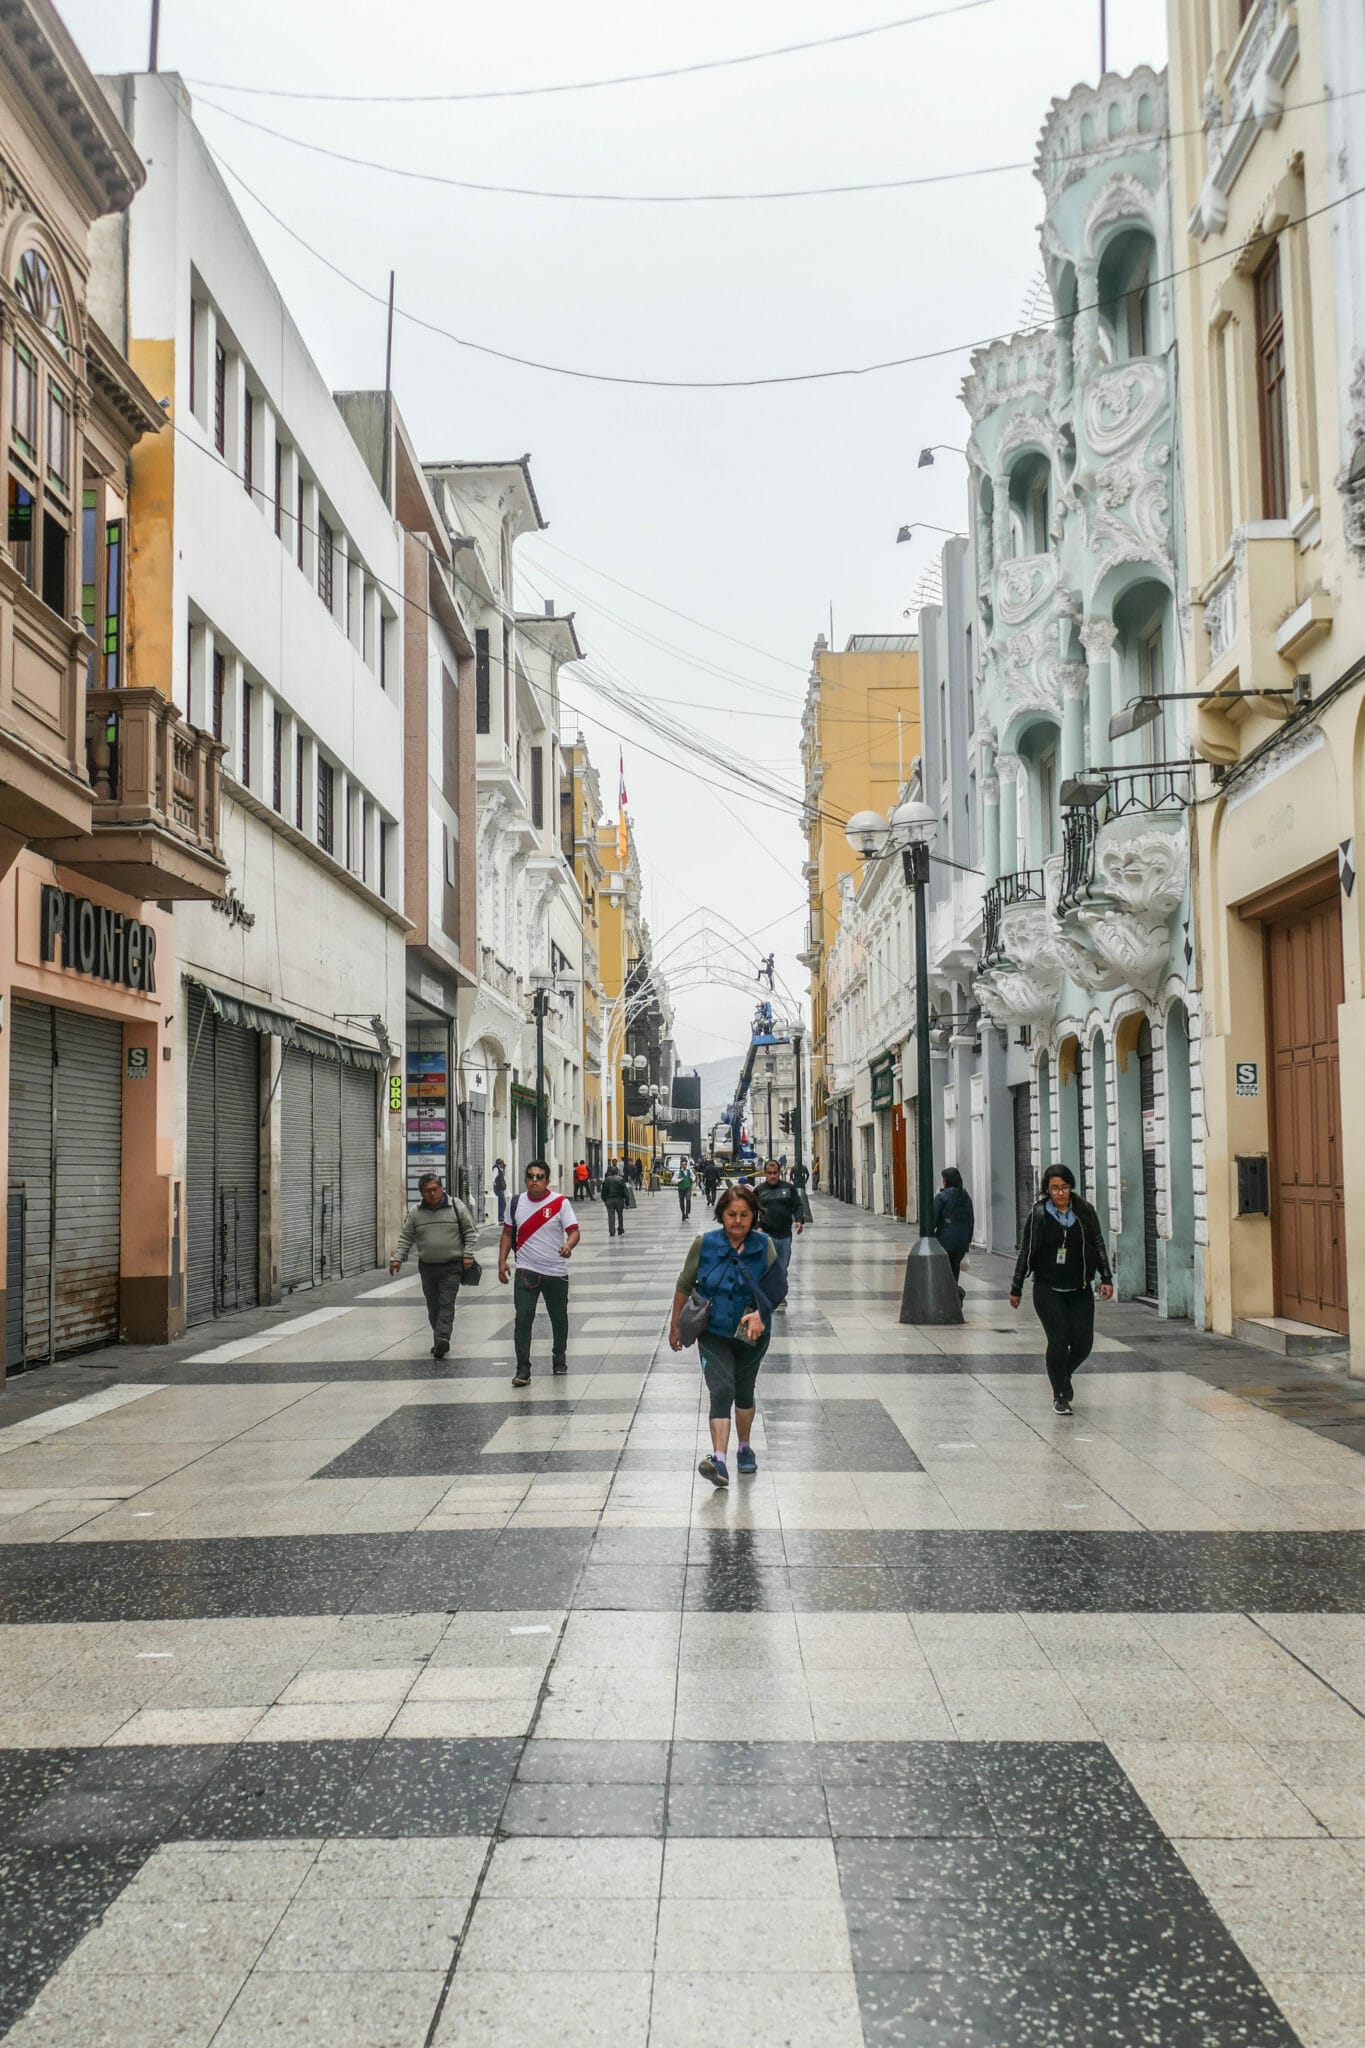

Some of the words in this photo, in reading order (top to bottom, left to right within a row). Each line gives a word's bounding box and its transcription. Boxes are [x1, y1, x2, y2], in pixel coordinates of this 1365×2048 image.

[131, 1048, 145, 1066] S
[1239, 1065, 1255, 1083] S
[391, 1076, 401, 1109] ORO
